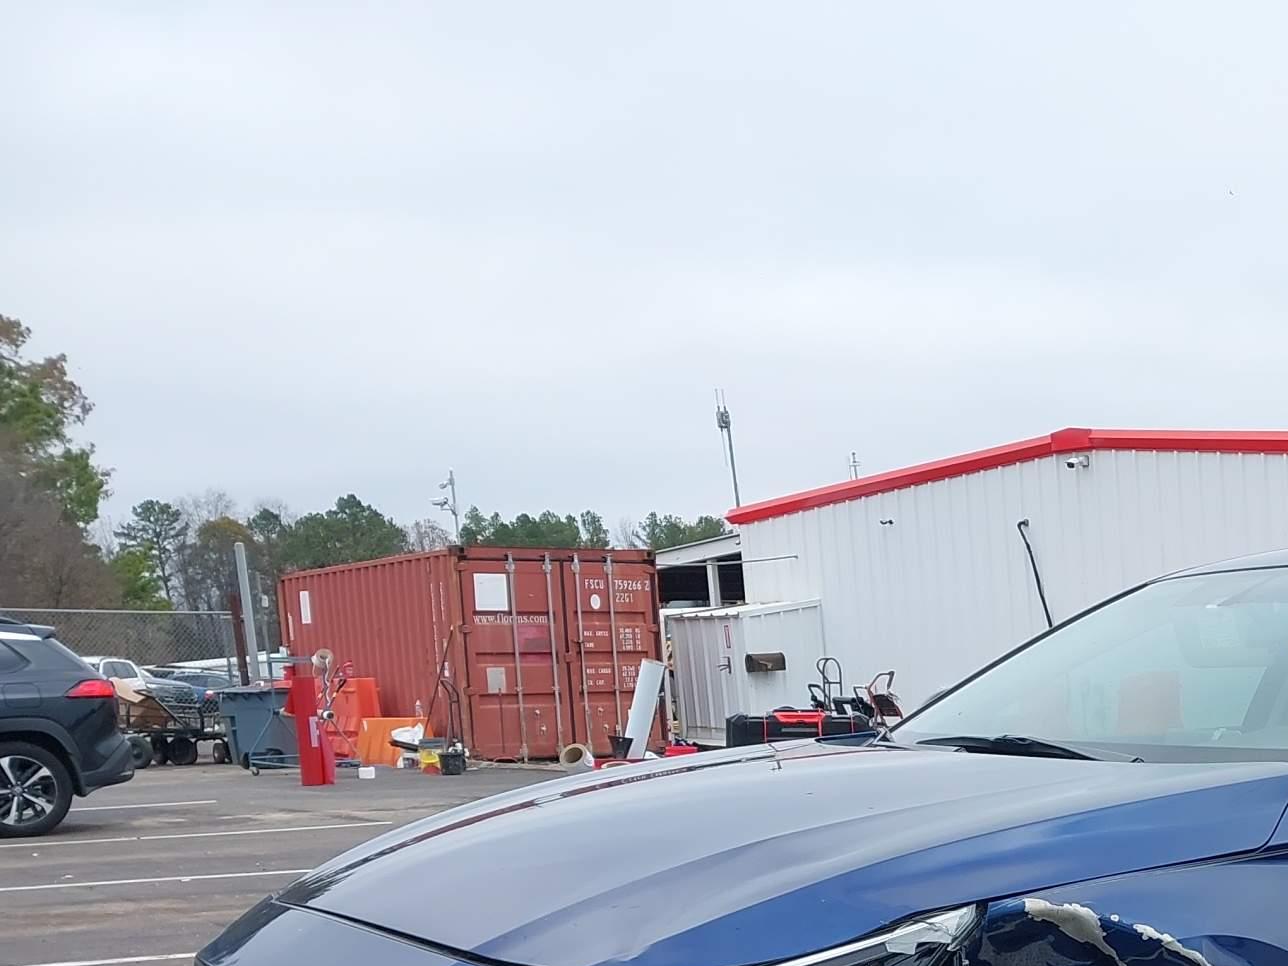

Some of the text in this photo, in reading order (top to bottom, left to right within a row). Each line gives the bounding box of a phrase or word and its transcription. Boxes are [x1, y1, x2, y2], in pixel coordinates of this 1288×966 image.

[584, 579, 604, 589] FSCU
[614, 579, 642, 590] 759266
[472, 612, 548, 625] www.florns.com
